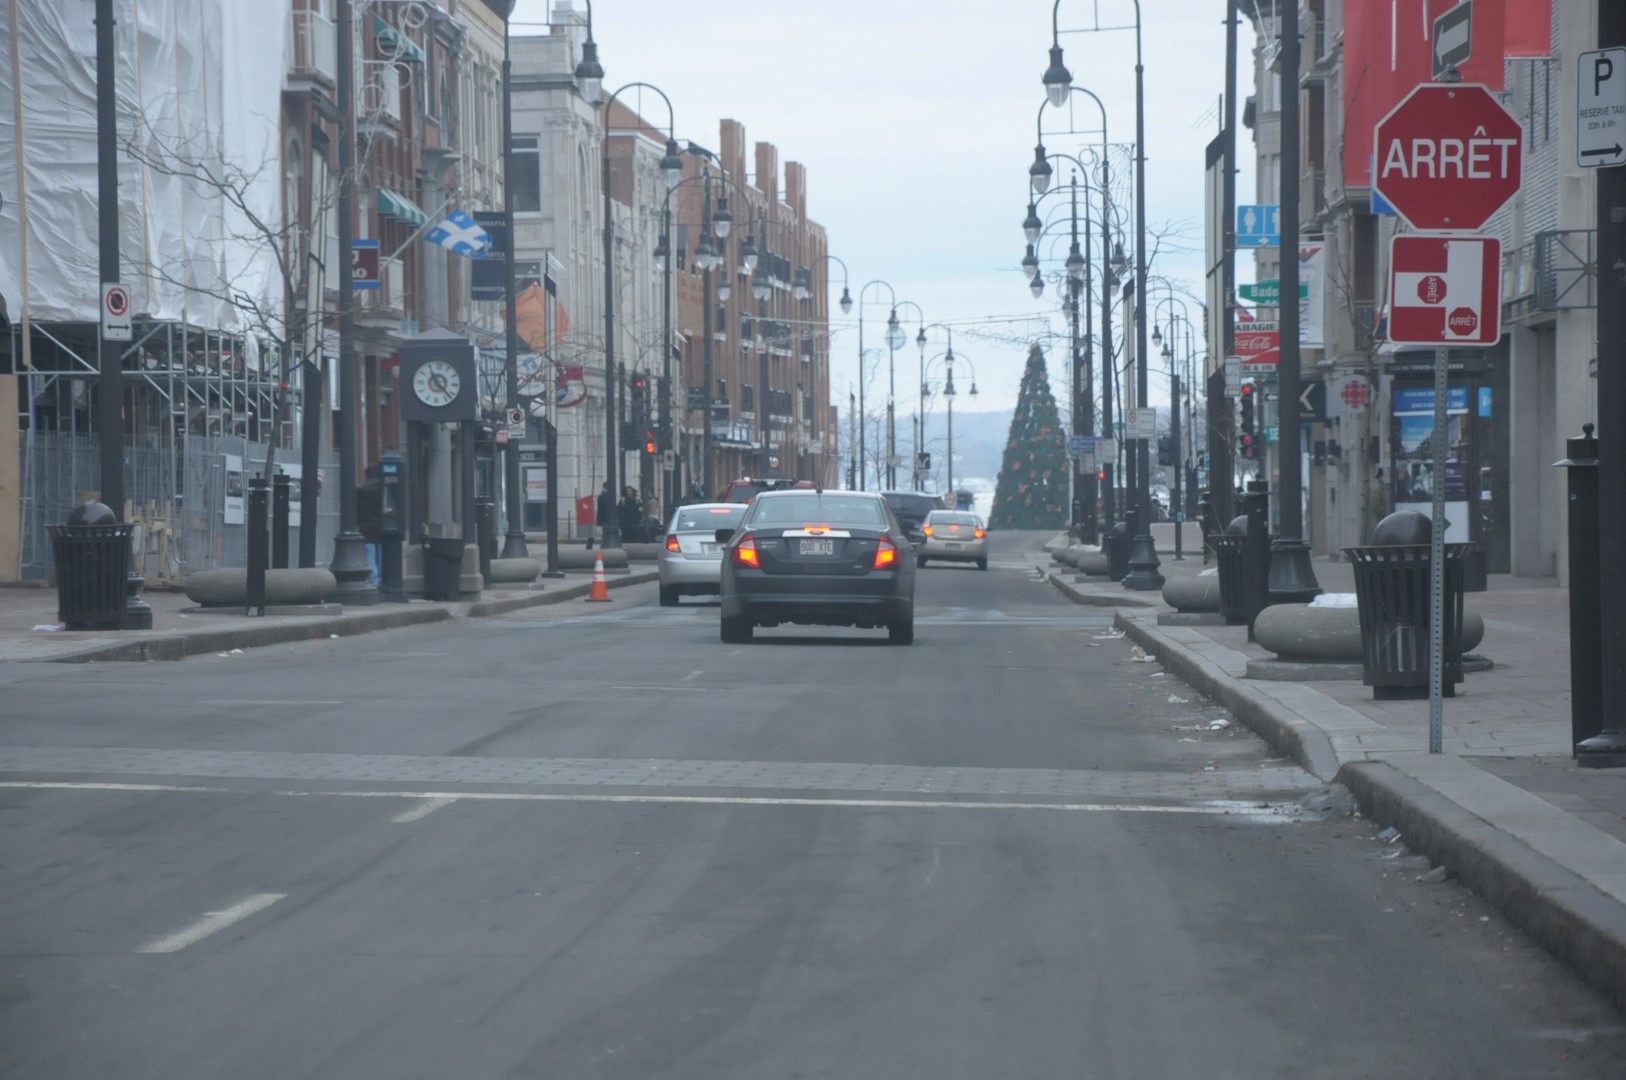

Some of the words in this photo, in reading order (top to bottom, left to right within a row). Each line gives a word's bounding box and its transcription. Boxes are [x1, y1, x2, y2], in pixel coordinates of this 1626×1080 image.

[1595, 58, 1613, 96] P
[1587, 121, 1600, 130] 23h
[1381, 125, 1517, 178] ARRÊT
[1250, 286, 1280, 297] Bade
[1427, 277, 1439, 303] ARRÊT
[1235, 323, 1275, 331] ABAGIE
